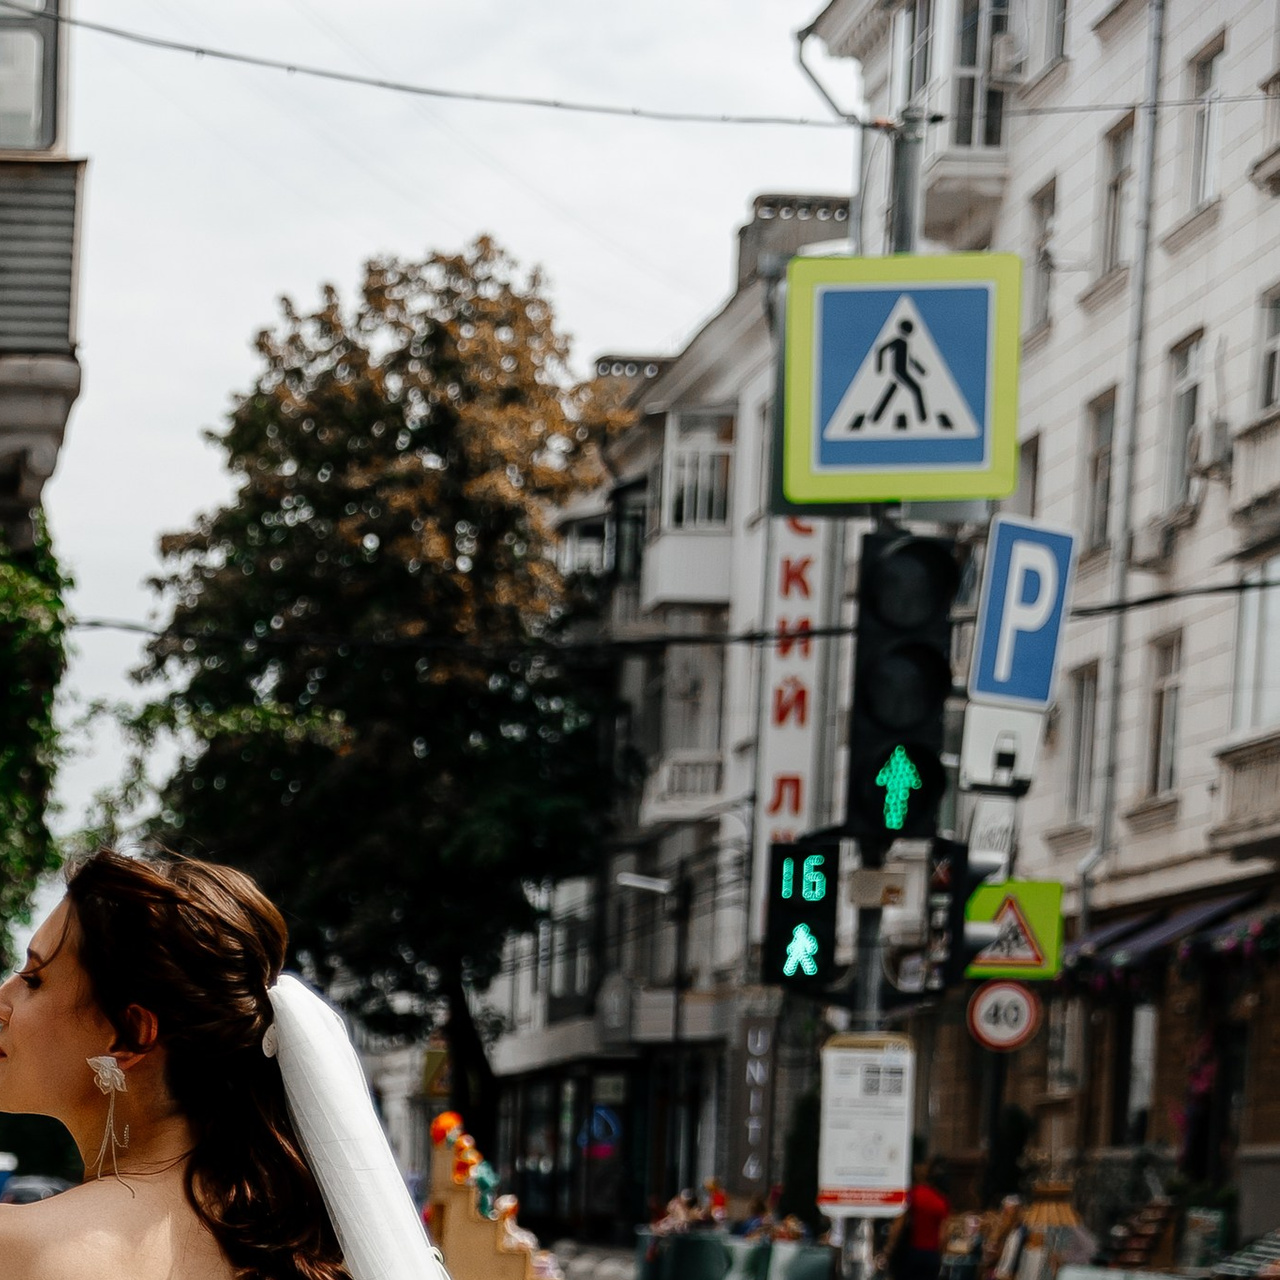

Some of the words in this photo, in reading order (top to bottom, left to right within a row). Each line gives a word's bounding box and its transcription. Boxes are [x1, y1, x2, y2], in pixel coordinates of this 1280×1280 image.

[993, 538, 1060, 683] P
[781, 855, 826, 901] 16
[984, 1000, 1022, 1029] 40
